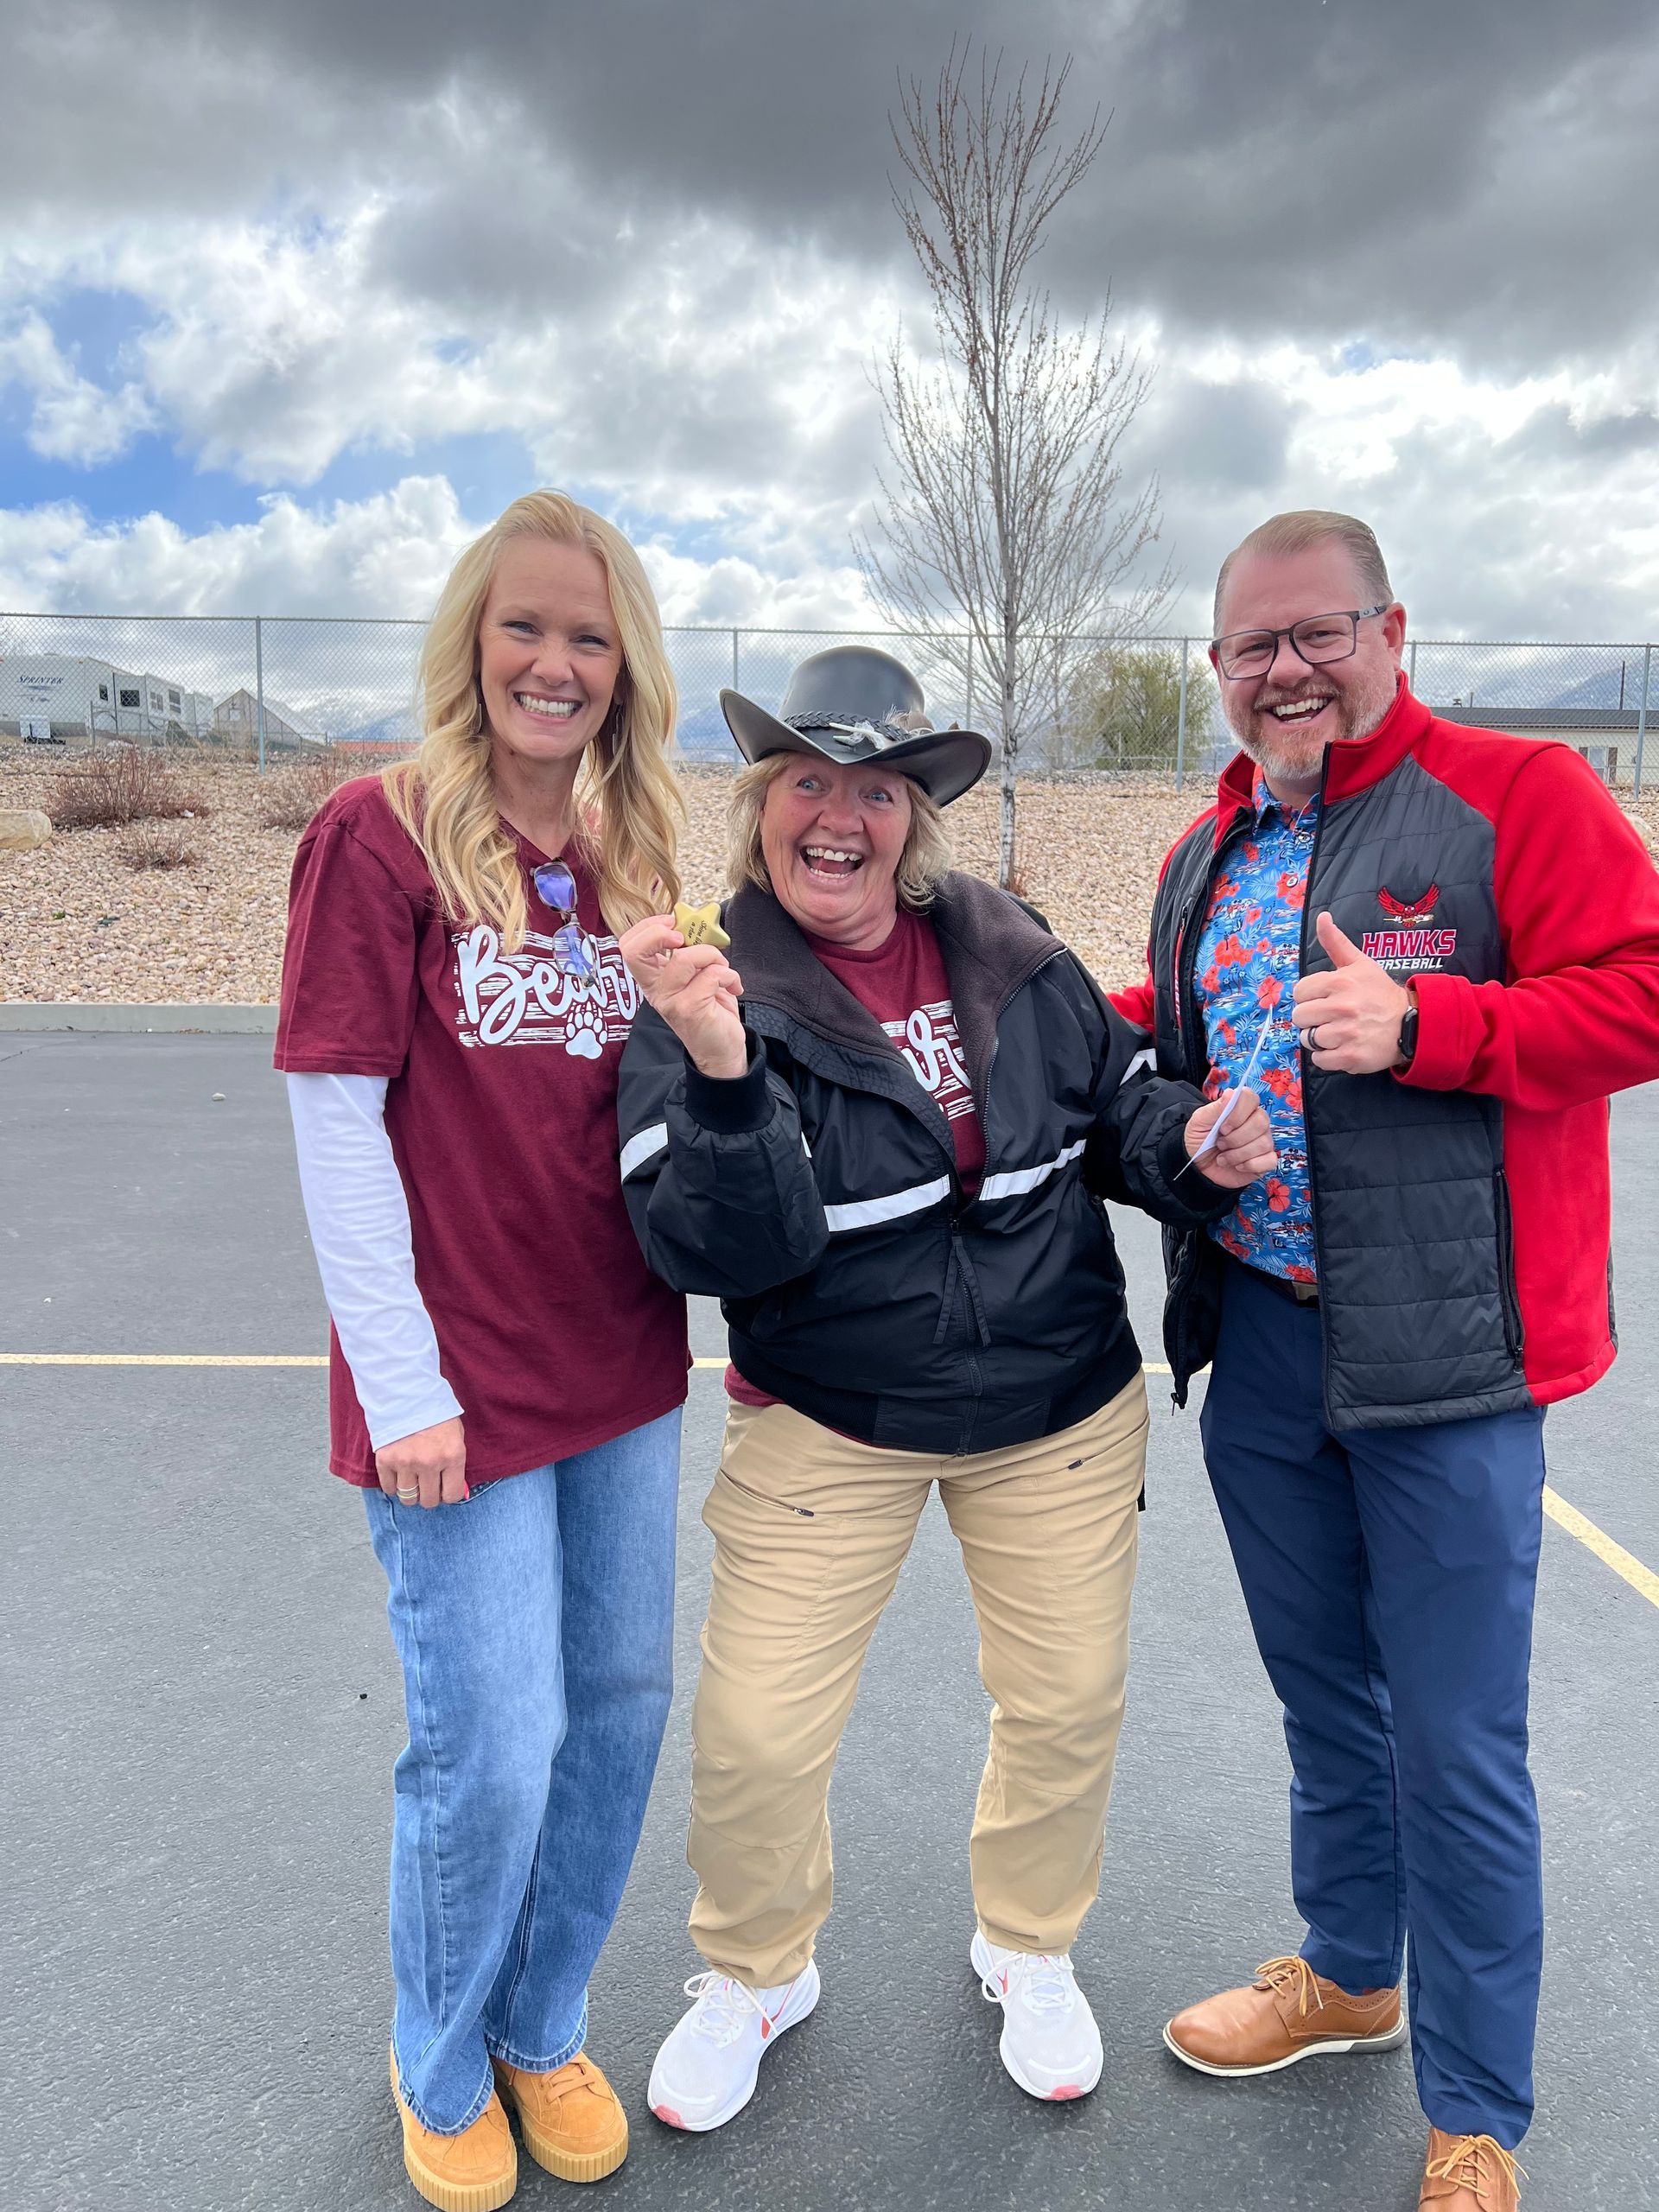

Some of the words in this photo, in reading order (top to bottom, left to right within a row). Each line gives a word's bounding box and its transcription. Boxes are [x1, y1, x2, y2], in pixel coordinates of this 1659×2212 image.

[16, 674, 63, 684] SPRINTER
[1362, 929, 1458, 958] HAWKS
[1376, 957, 1444, 970] BASEBALL
